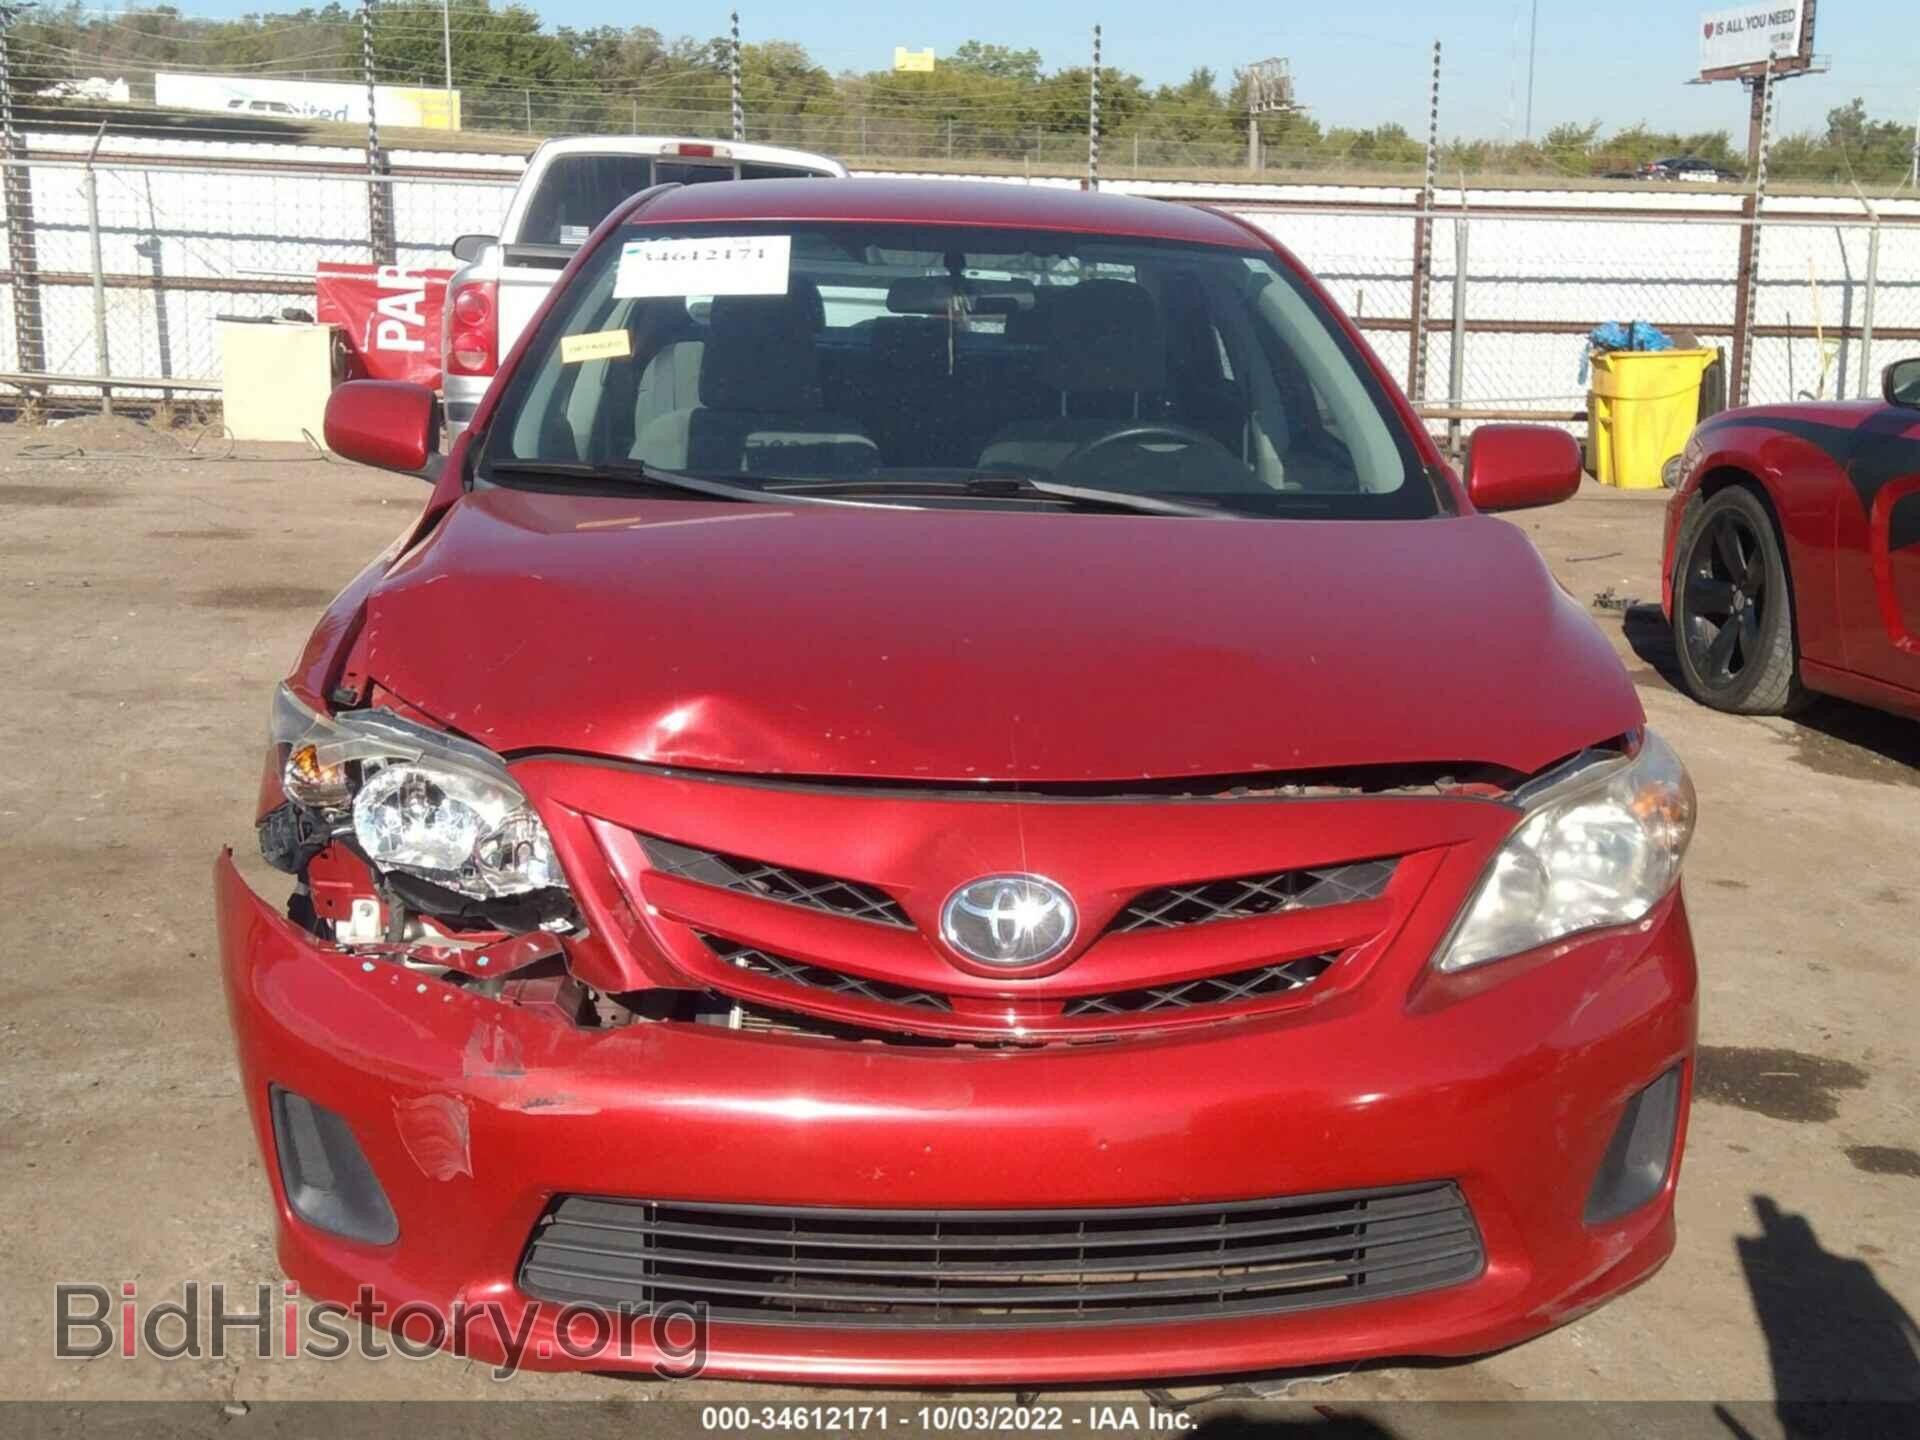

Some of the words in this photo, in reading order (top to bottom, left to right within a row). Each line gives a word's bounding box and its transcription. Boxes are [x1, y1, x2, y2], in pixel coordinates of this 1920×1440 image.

[1716, 22, 1725, 35] IS
[1727, 19, 1744, 33] ALL
[1746, 15, 1766, 30] YOU
[1768, 9, 1796, 26] NEED
[377, 265, 426, 352] PAR
